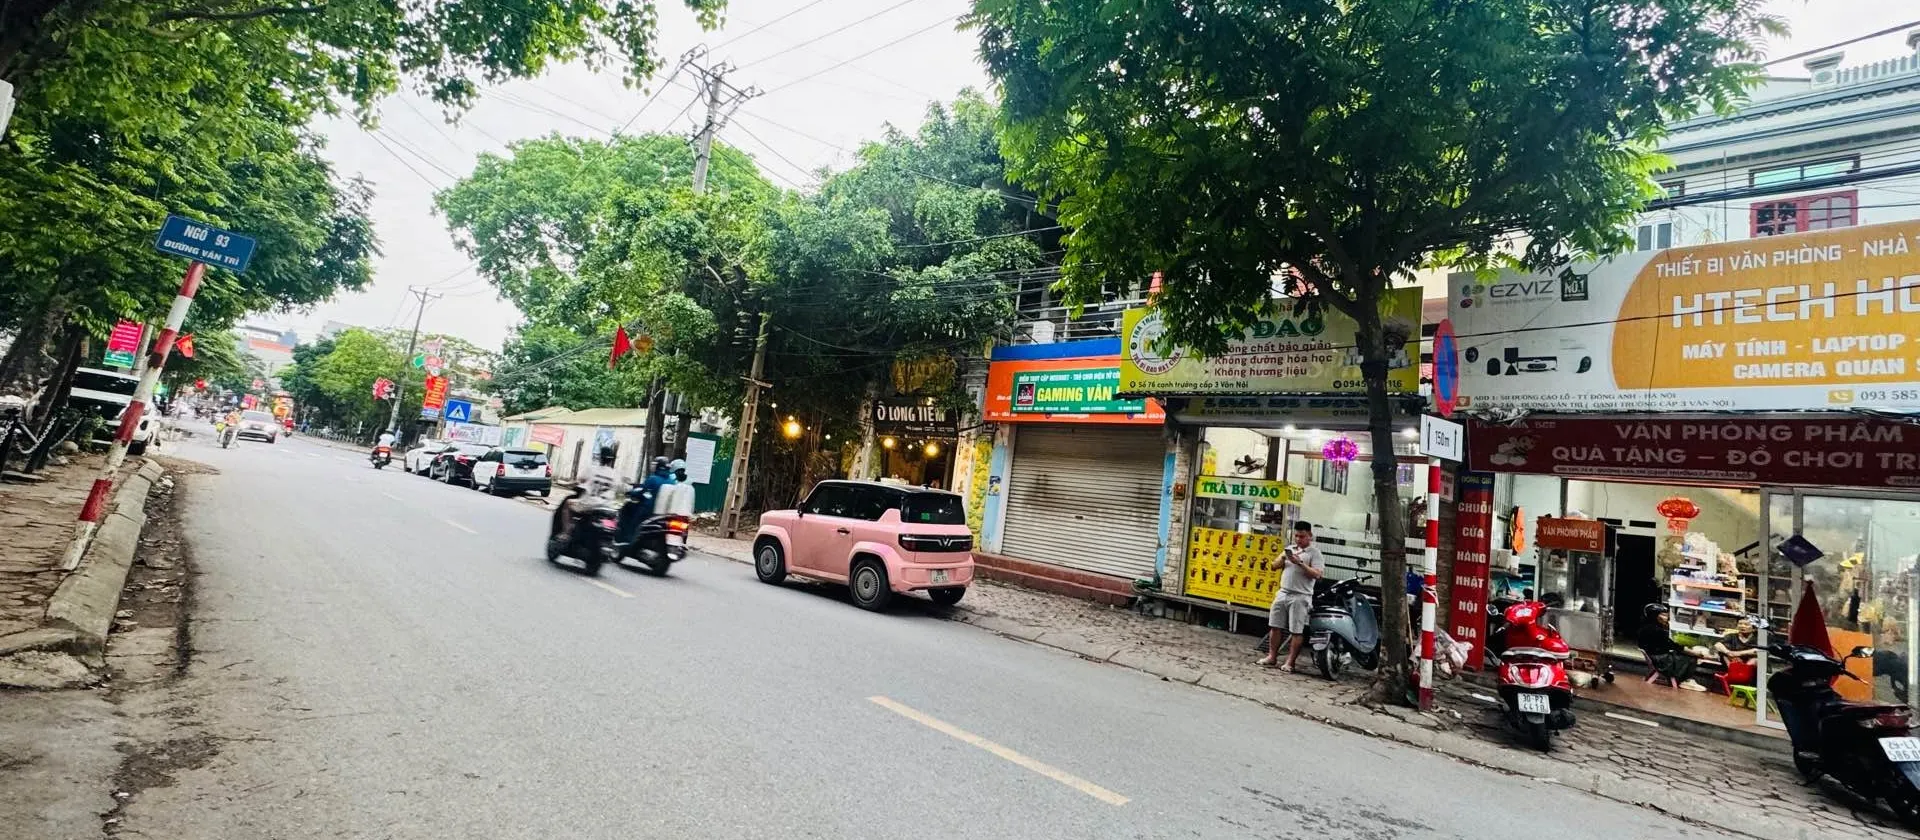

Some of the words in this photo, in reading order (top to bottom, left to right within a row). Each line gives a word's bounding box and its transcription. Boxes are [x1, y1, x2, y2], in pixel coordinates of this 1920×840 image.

[215, 234, 230, 248] 93
[1655, 252, 1701, 278] THIẾT
[1707, 257, 1724, 277] BỊ
[1730, 250, 1767, 270] VĂN
[1773, 243, 1841, 266] PHÒNG
[1863, 231, 1909, 258] NHÀ
[1490, 280, 1554, 298] EZVIZ
[1564, 280, 1585, 294] NO.1
[1672, 282, 1835, 329] HTECH
[1250, 341, 1275, 352] chất
[1279, 341, 1299, 352] bảo
[1682, 340, 1727, 359] MÁY
[1735, 337, 1787, 357] TÍNH
[1811, 333, 1906, 354] LAPTOP
[1250, 355, 1284, 366] đường
[1311, 353, 1333, 365] học
[1214, 367, 1247, 378] Không
[1249, 367, 1283, 378] hương
[1286, 366, 1307, 377] liệu
[1733, 361, 1826, 379] CAMERA
[1835, 357, 1905, 377] QUAN
[1036, 386, 1083, 402] GAMING
[1087, 384, 1112, 402] VÂN
[1860, 390, 1886, 401] 093
[877, 400, 886, 421] Ô
[888, 406, 916, 422] LONG
[1615, 422, 1672, 440] VĂN
[1682, 421, 1793, 442] PHÒNG
[1804, 418, 1904, 442] PHẨM
[1435, 430, 1450, 448] 150m
[1551, 443, 1606, 462] QUÀ
[1612, 444, 1687, 466] TẶNG
[1726, 445, 1772, 466] ĐỒ
[1783, 450, 1864, 468] CHƠI
[1876, 452, 1920, 470] TR
[1201, 480, 1228, 494] TRÀ
[1231, 482, 1245, 496] BÍ
[1248, 485, 1280, 498] ĐAO
[1458, 501, 1492, 514] CHUỖI
[1462, 525, 1485, 538] CỬA
[1456, 550, 1487, 563] HÀNG
[1455, 575, 1484, 589] NHẬT
[1458, 600, 1478, 614] NỘI
[1457, 625, 1477, 639] ĐỊA
